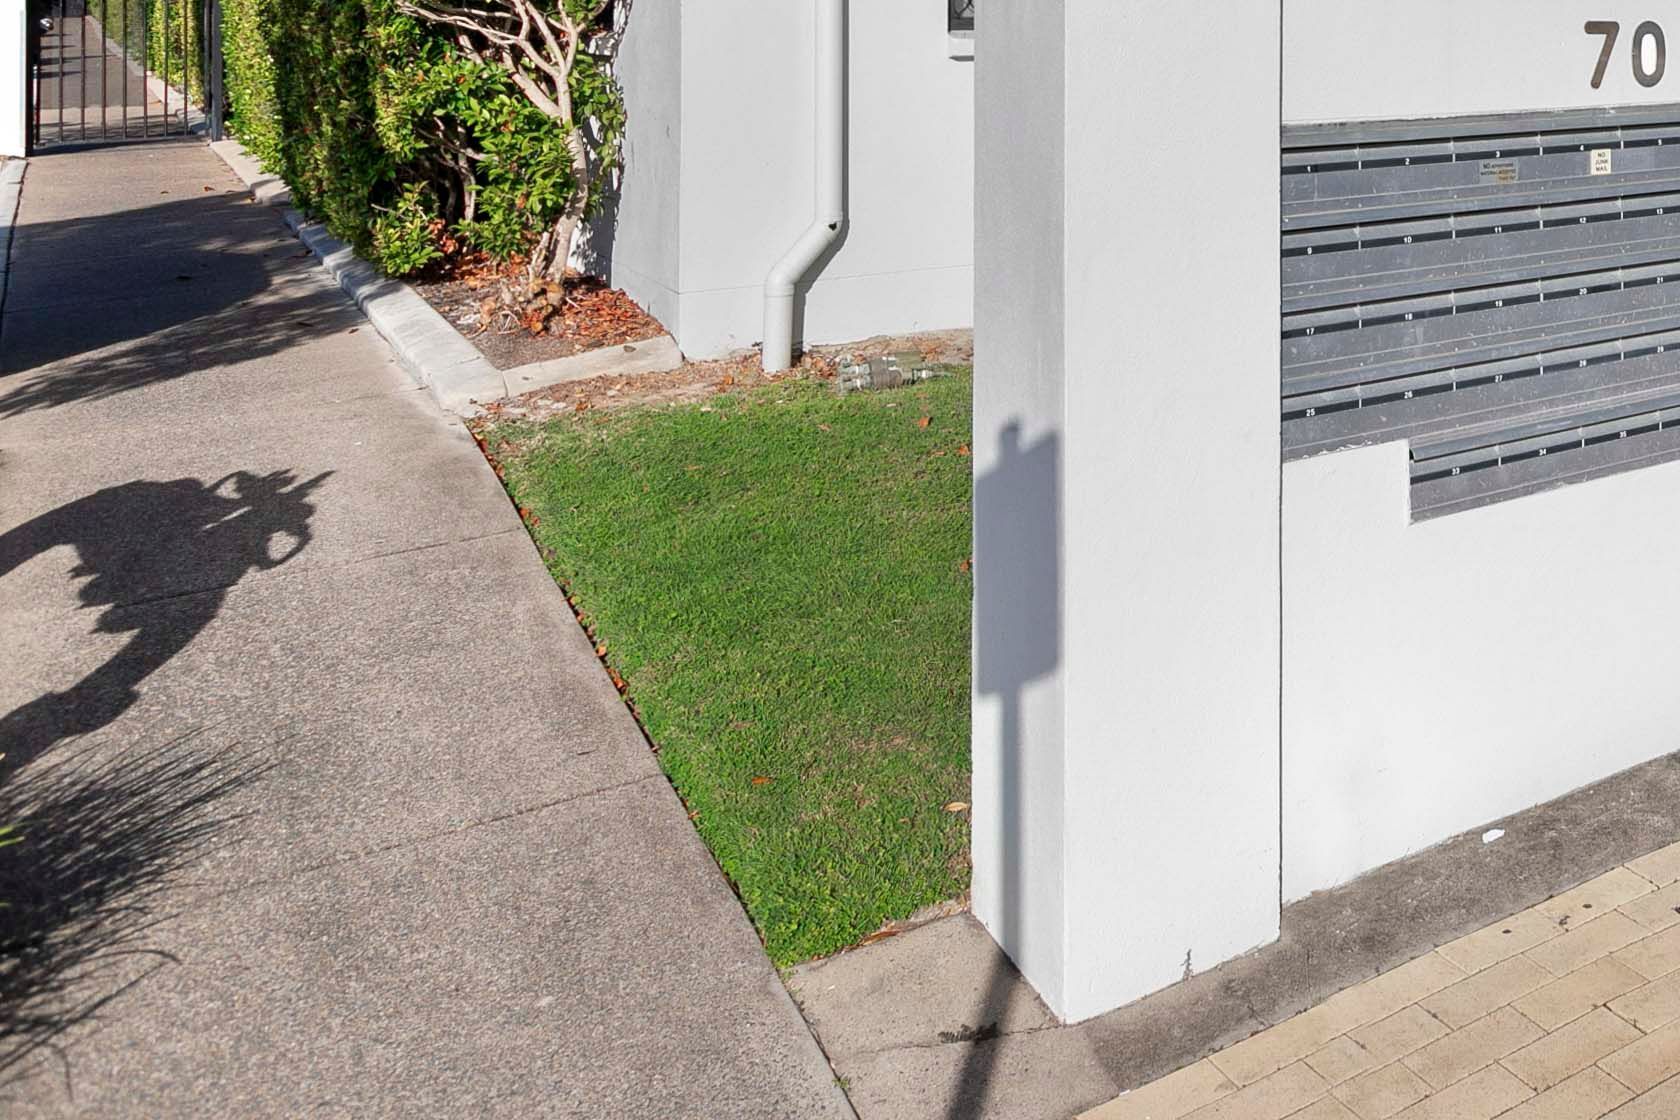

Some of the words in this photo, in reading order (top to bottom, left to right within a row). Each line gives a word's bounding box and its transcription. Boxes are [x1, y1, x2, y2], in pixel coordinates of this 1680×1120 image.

[1584, 21, 1666, 89] 70
[1403, 235, 1413, 244] 10
[1578, 287, 1588, 295] 20
[1404, 312, 1413, 321] 18
[1306, 327, 1315, 336] 17
[1494, 374, 1503, 382] 27
[1403, 390, 1414, 399] 26
[1306, 408, 1316, 417] 25
[1451, 467, 1461, 476] 33
